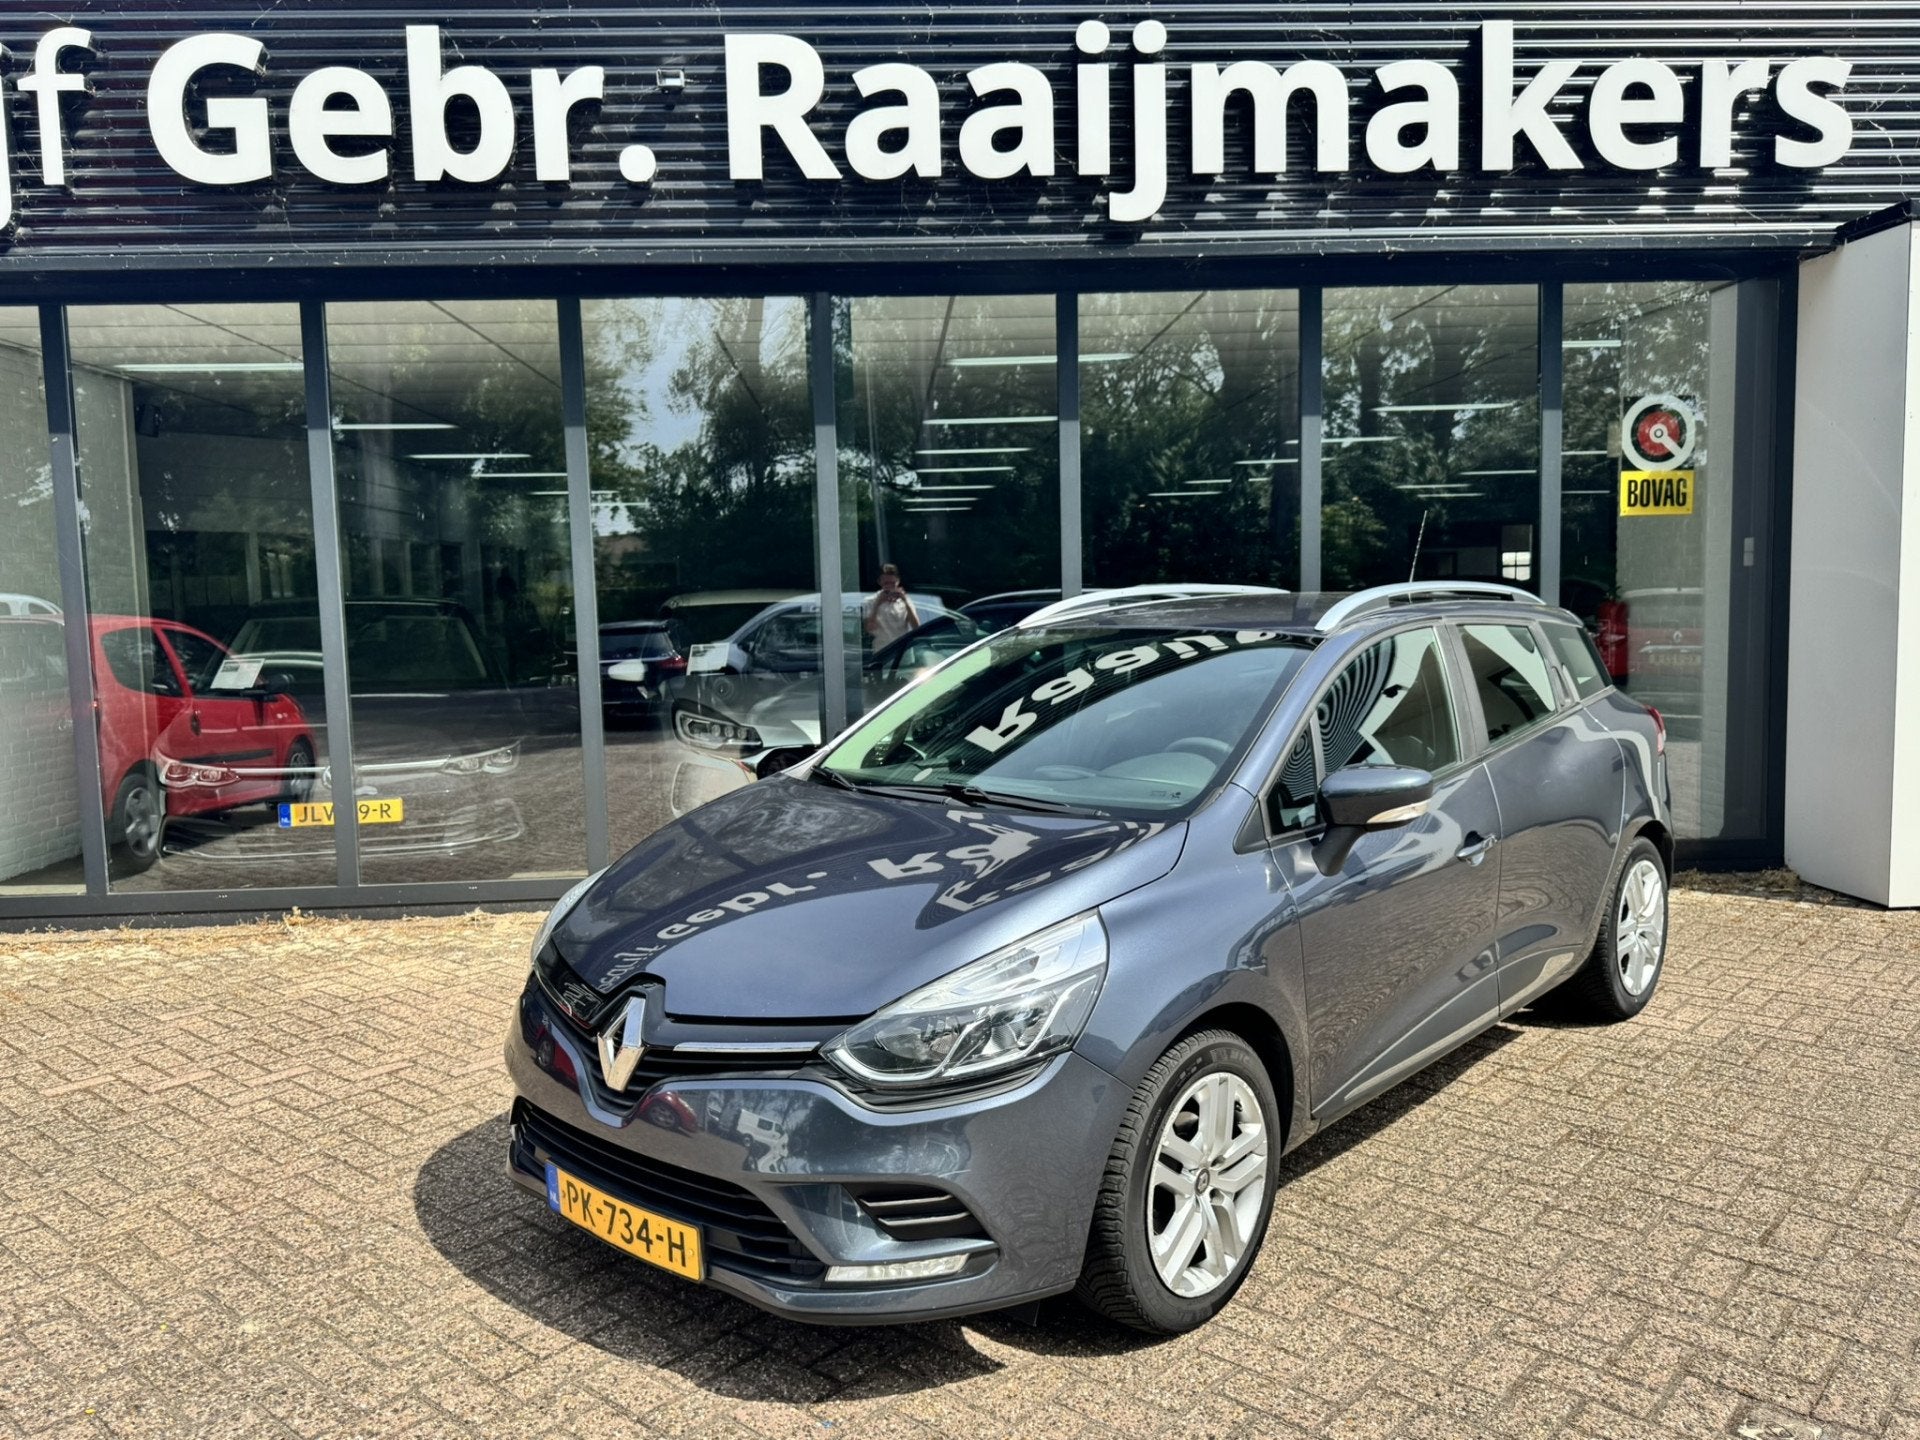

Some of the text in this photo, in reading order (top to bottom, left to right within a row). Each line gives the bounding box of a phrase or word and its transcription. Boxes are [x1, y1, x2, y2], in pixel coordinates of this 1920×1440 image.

[0, 20, 1854, 230] f Gebr. Raaijmakers
[1627, 478, 1687, 508] BOVAG
[566, 1180, 686, 1267] PK-734-H
